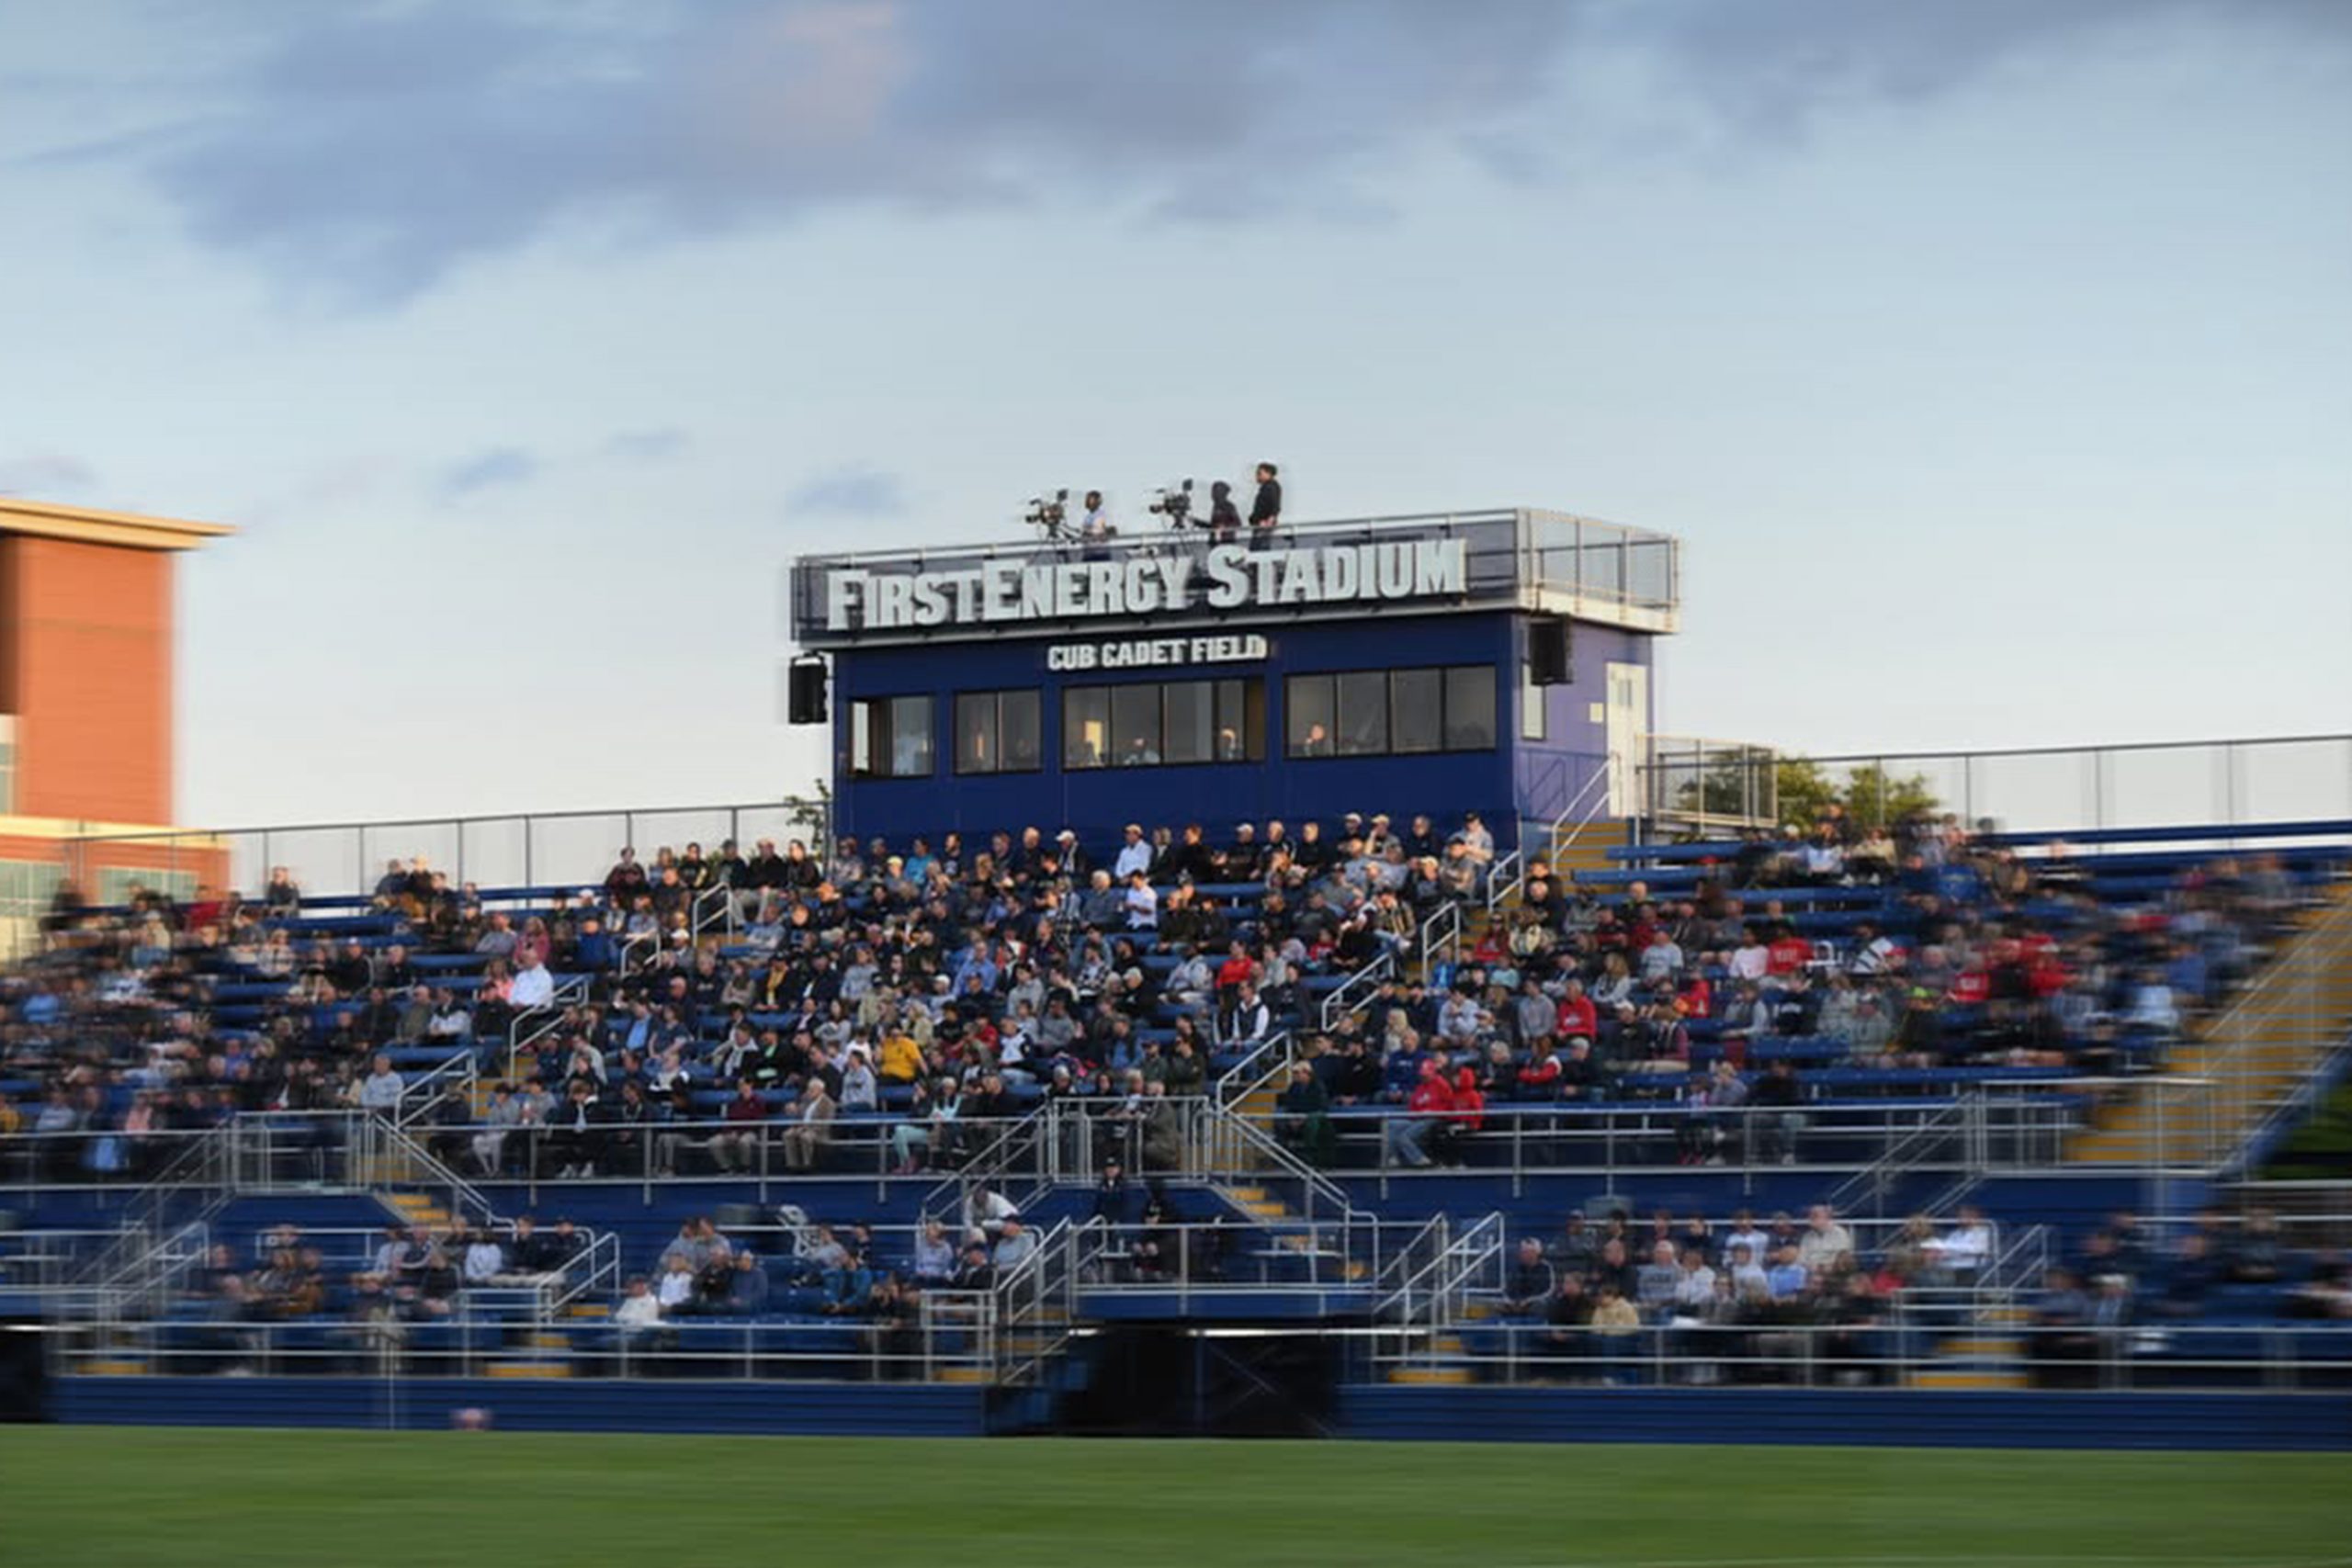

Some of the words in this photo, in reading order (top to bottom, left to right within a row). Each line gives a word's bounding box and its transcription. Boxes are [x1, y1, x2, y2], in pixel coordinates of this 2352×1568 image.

[1207, 538, 1467, 609] STADIUM
[1048, 645, 1097, 671] CUB
[1102, 639, 1187, 668] CADET
[1191, 634, 1268, 663] FIELD
